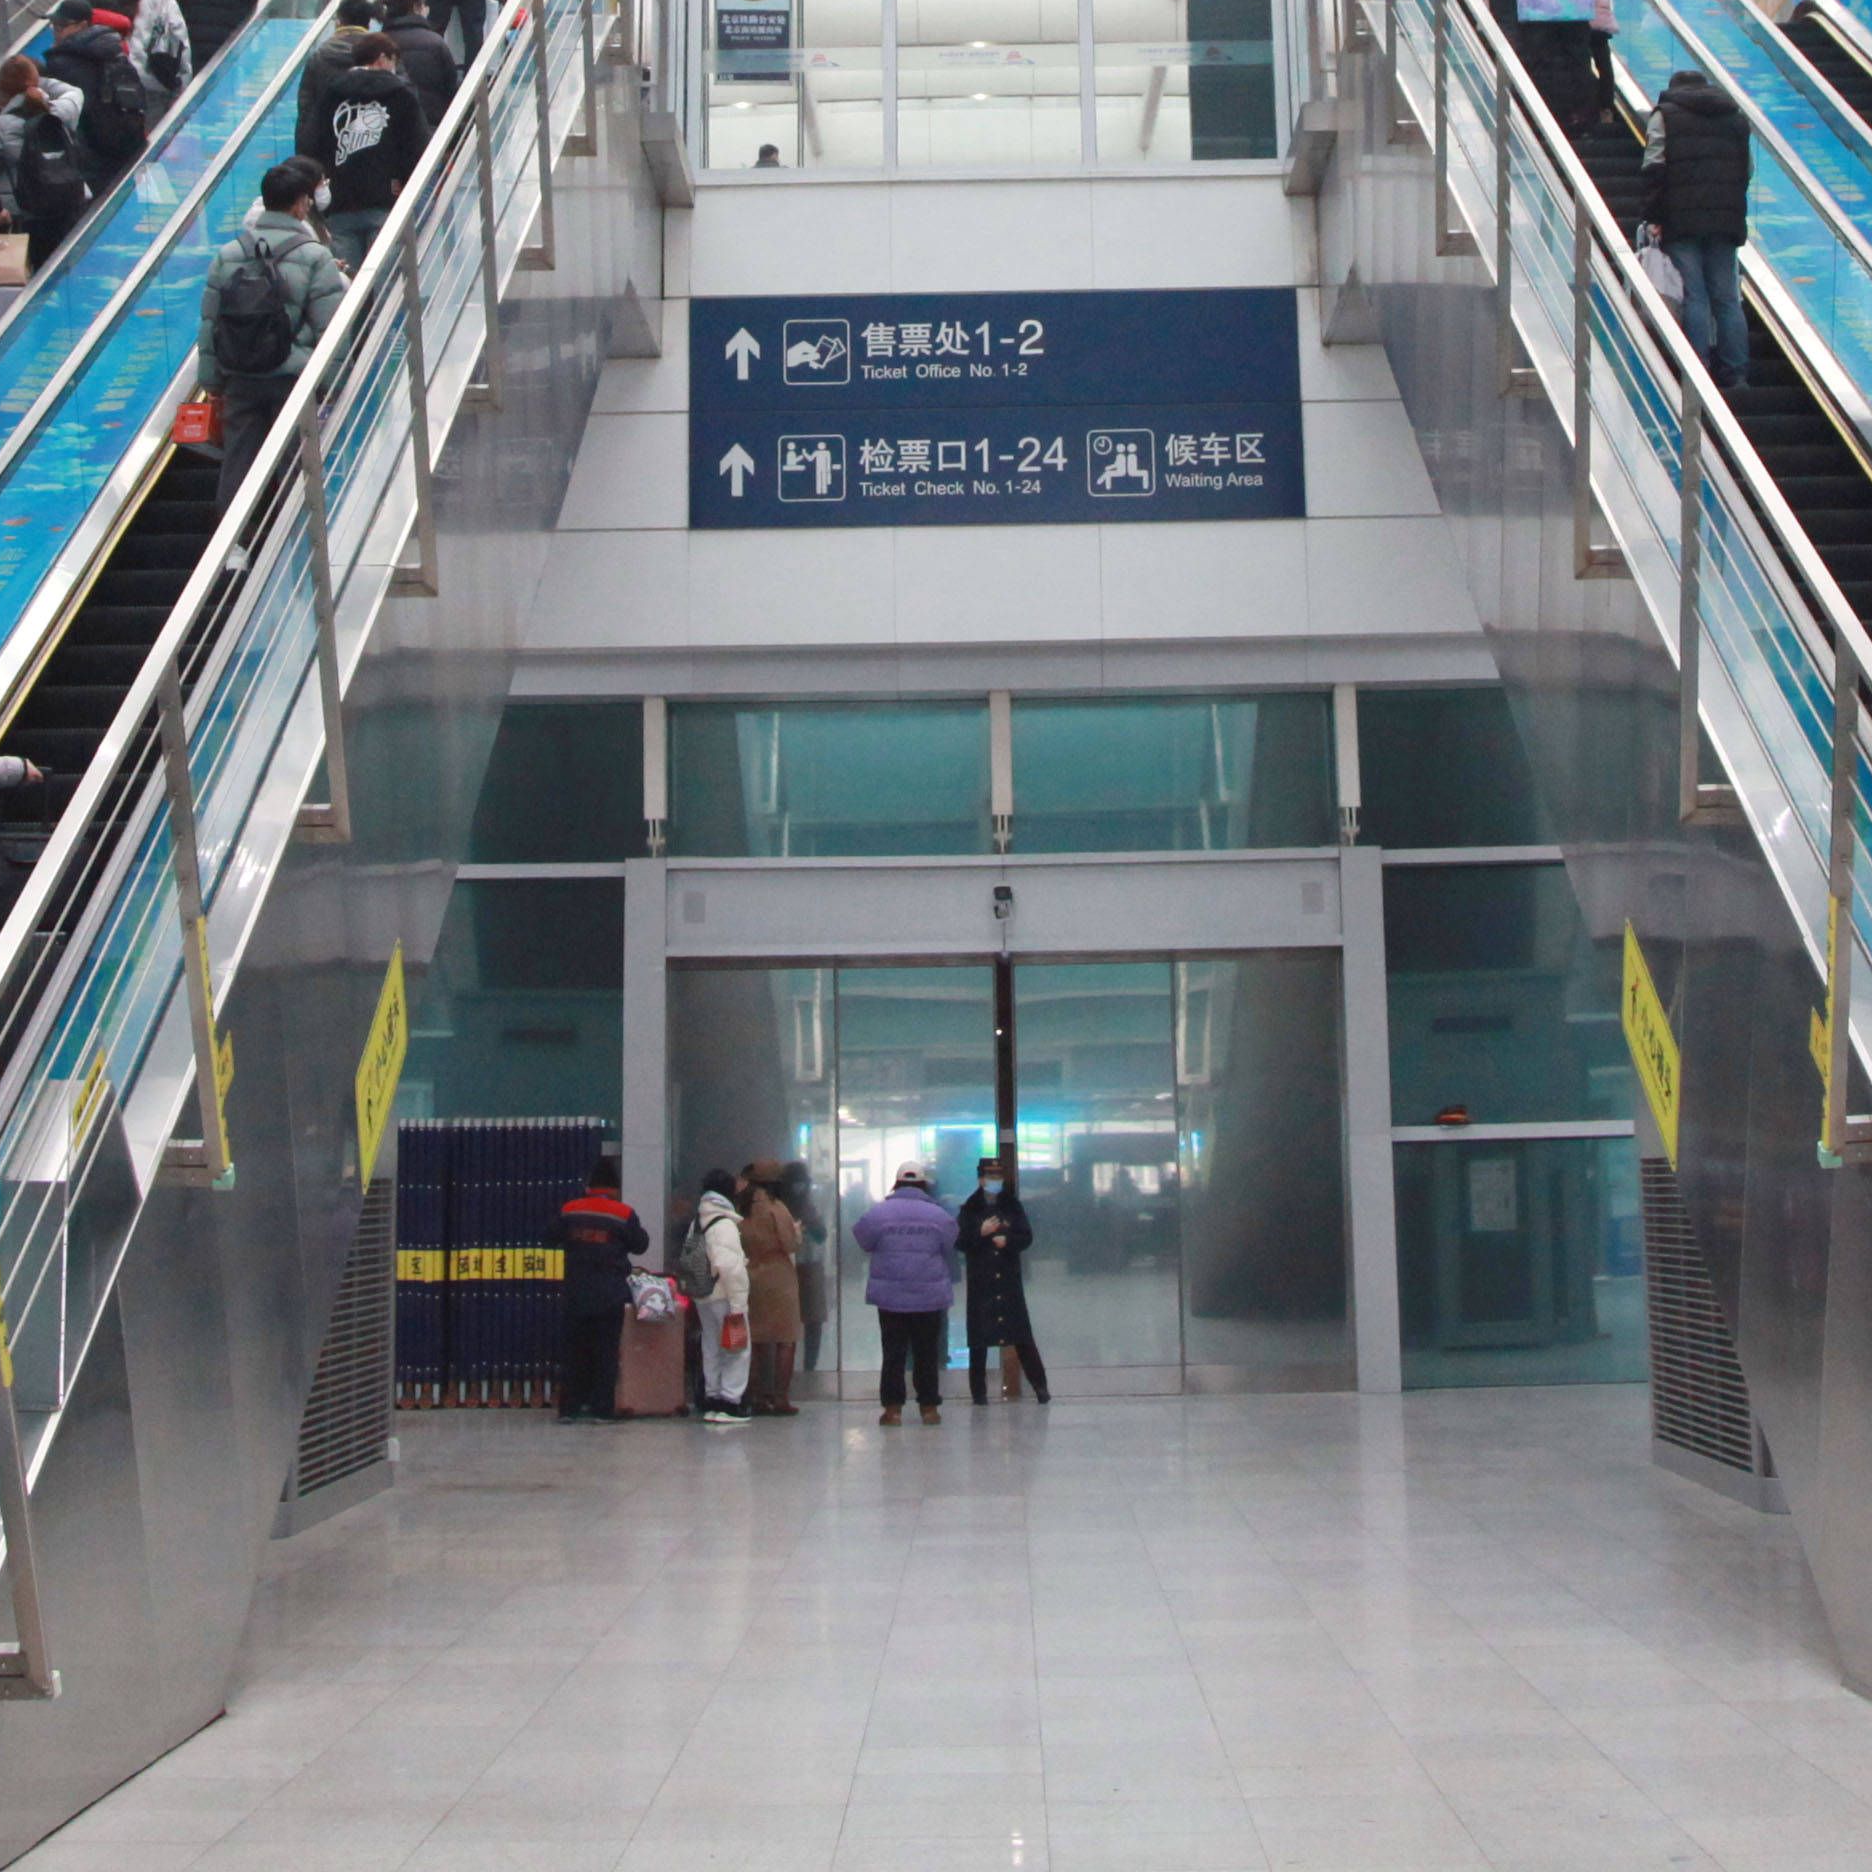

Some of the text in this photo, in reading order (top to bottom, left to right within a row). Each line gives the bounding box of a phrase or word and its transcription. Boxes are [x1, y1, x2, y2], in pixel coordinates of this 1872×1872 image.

[861, 318, 1045, 359] 售票处1-2
[860, 362, 1028, 380] Ticket Office No. 1-2
[859, 436, 1069, 476] 检票口1-24
[1165, 432, 1267, 468] 候车区
[859, 478, 1041, 497] Ticket Check No. 1-24
[1165, 470, 1264, 489] Waiting Area
